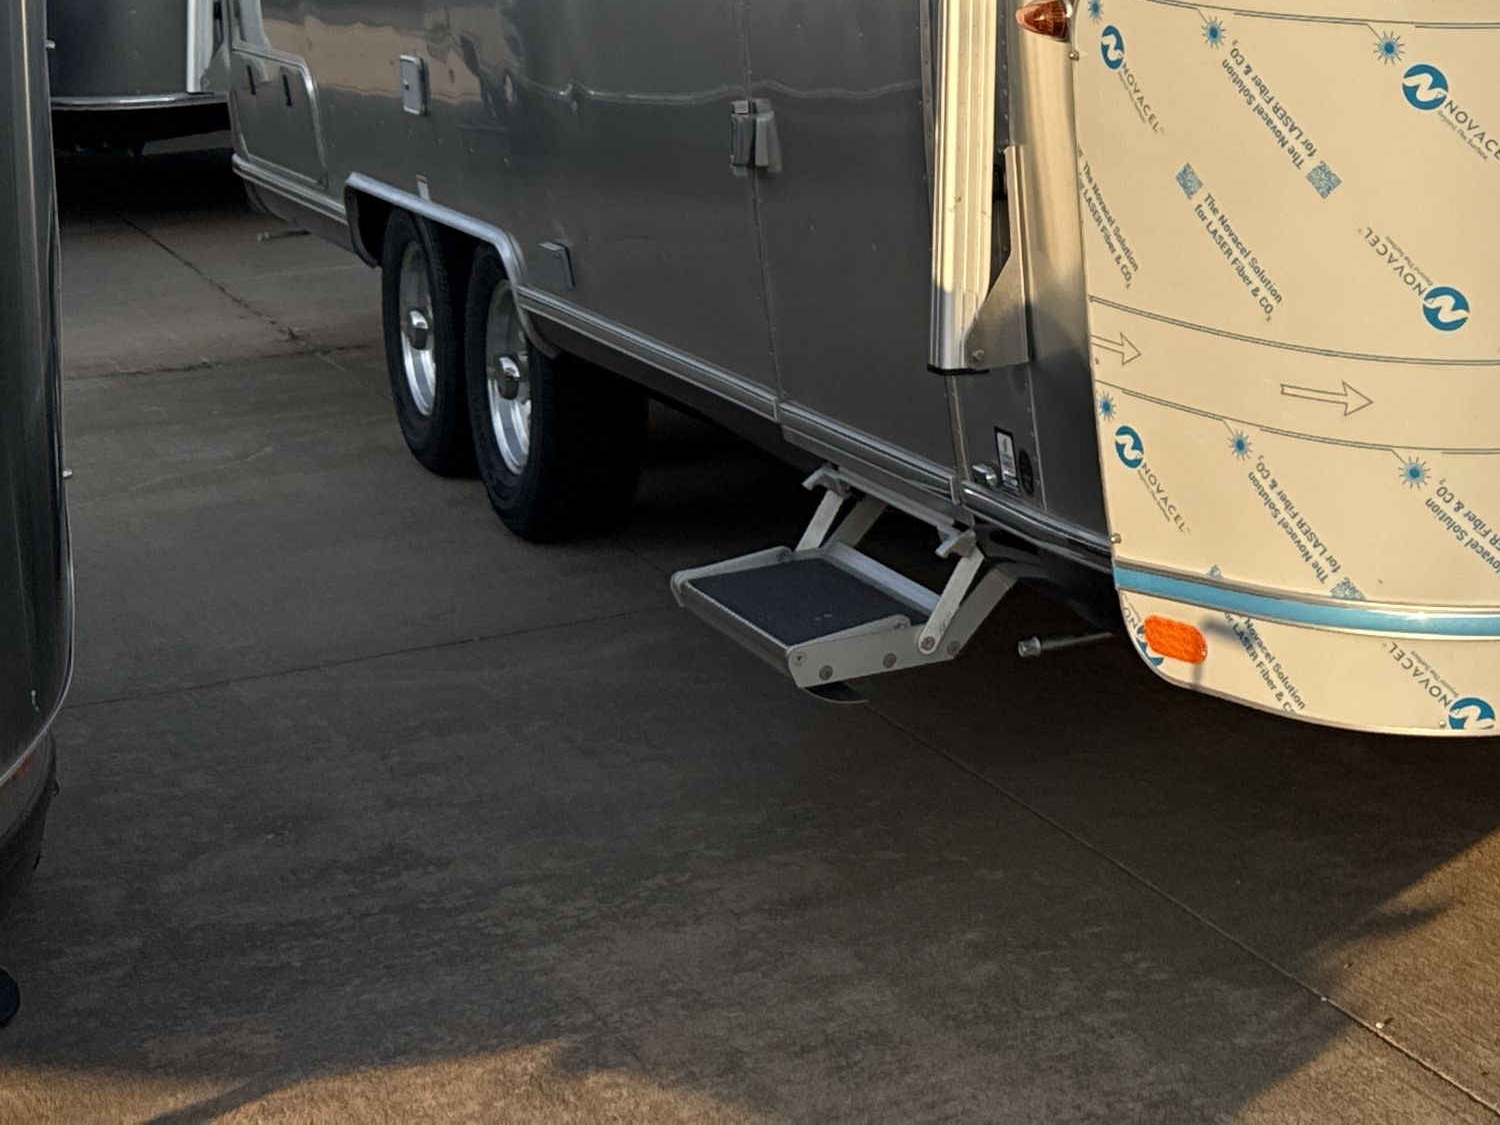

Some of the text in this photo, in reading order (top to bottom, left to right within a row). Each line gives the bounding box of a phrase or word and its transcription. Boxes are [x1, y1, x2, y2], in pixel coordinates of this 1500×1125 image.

[1243, 64, 1253, 75] &
[1251, 75, 1275, 105] Fiber
[1121, 62, 1160, 133] NOVACEL
[1221, 58, 1304, 170] The Novacel Solution
[1272, 102, 1304, 140] LASER
[1301, 139, 1317, 157] for
[1083, 189, 1102, 227] LASER
[1083, 161, 1138, 272] The Novacel Solution
[1194, 204, 1208, 222] for
[1206, 220, 1233, 259] LASER
[1231, 257, 1253, 286] Fiber
[1251, 286, 1260, 297] &
[1204, 193, 1282, 304] The Novacel Solution
[1364, 227, 1428, 296] NOVACEL
[1141, 462, 1186, 533] NOVACEL
[1268, 478, 1278, 490] &
[1276, 490, 1299, 520] Fiber
[1248, 471, 1329, 584] The Novacel Solution
[1425, 498, 1468, 541] Solution
[1453, 500, 1465, 513] &
[1463, 510, 1493, 538] Fiber
[1296, 517, 1327, 556] LASER
[1325, 555, 1341, 573] for
[1232, 623, 1258, 662] LASER
[1256, 661, 1277, 690] Fiber
[1275, 691, 1284, 702] &
[1244, 617, 1306, 710] Novacel Solution
[1389, 642, 1453, 708] NOVACEL
